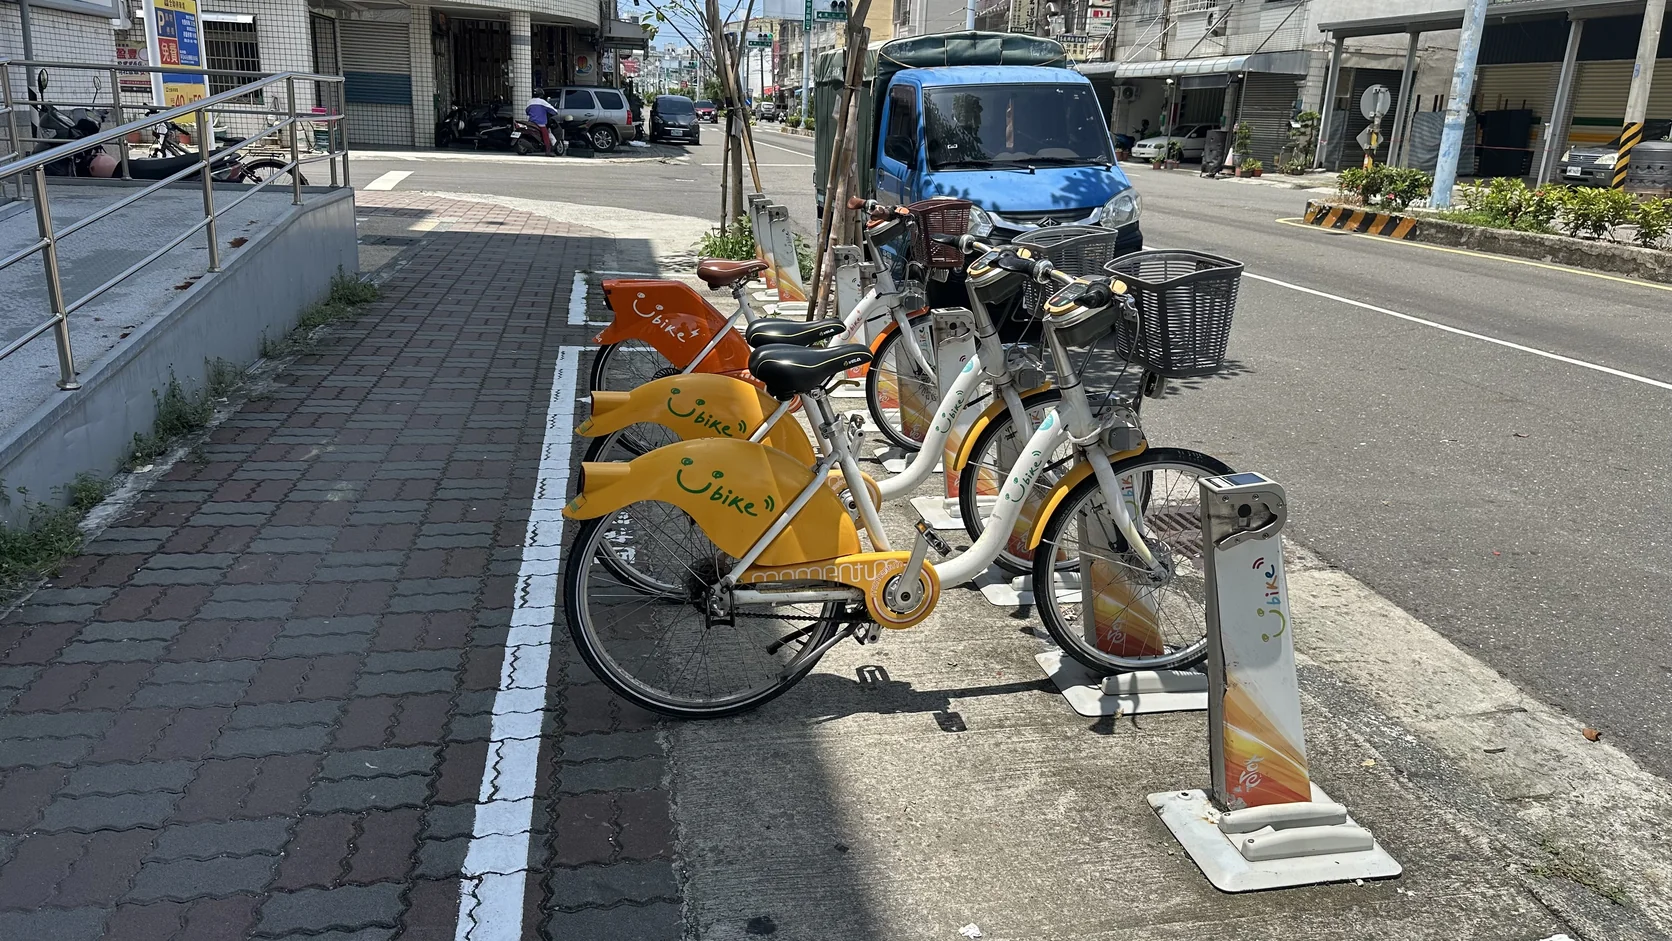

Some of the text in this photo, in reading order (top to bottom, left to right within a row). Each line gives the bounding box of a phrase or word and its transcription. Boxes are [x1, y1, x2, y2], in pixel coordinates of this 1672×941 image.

[157, 10, 165, 34] P
[161, 41, 178, 63] 免費
[751, 559, 901, 583] momentum
